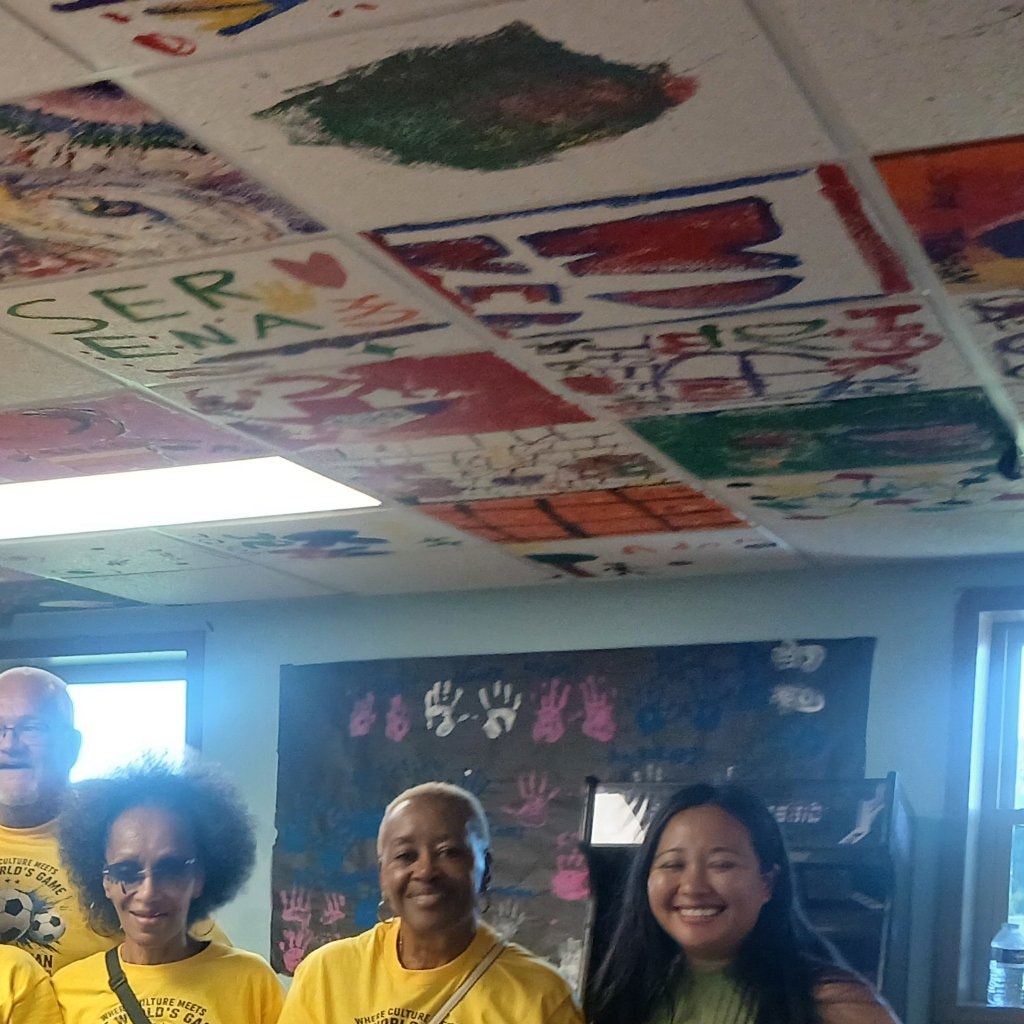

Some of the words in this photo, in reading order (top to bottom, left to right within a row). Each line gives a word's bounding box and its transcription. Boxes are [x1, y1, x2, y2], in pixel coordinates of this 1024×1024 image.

[34, 860, 58, 875] MEETS
[36, 872, 67, 896] GAME
[139, 997, 175, 1007] ULTURE
[177, 1000, 208, 1016] MEETS
[388, 1008, 430, 1022] CULTURE
